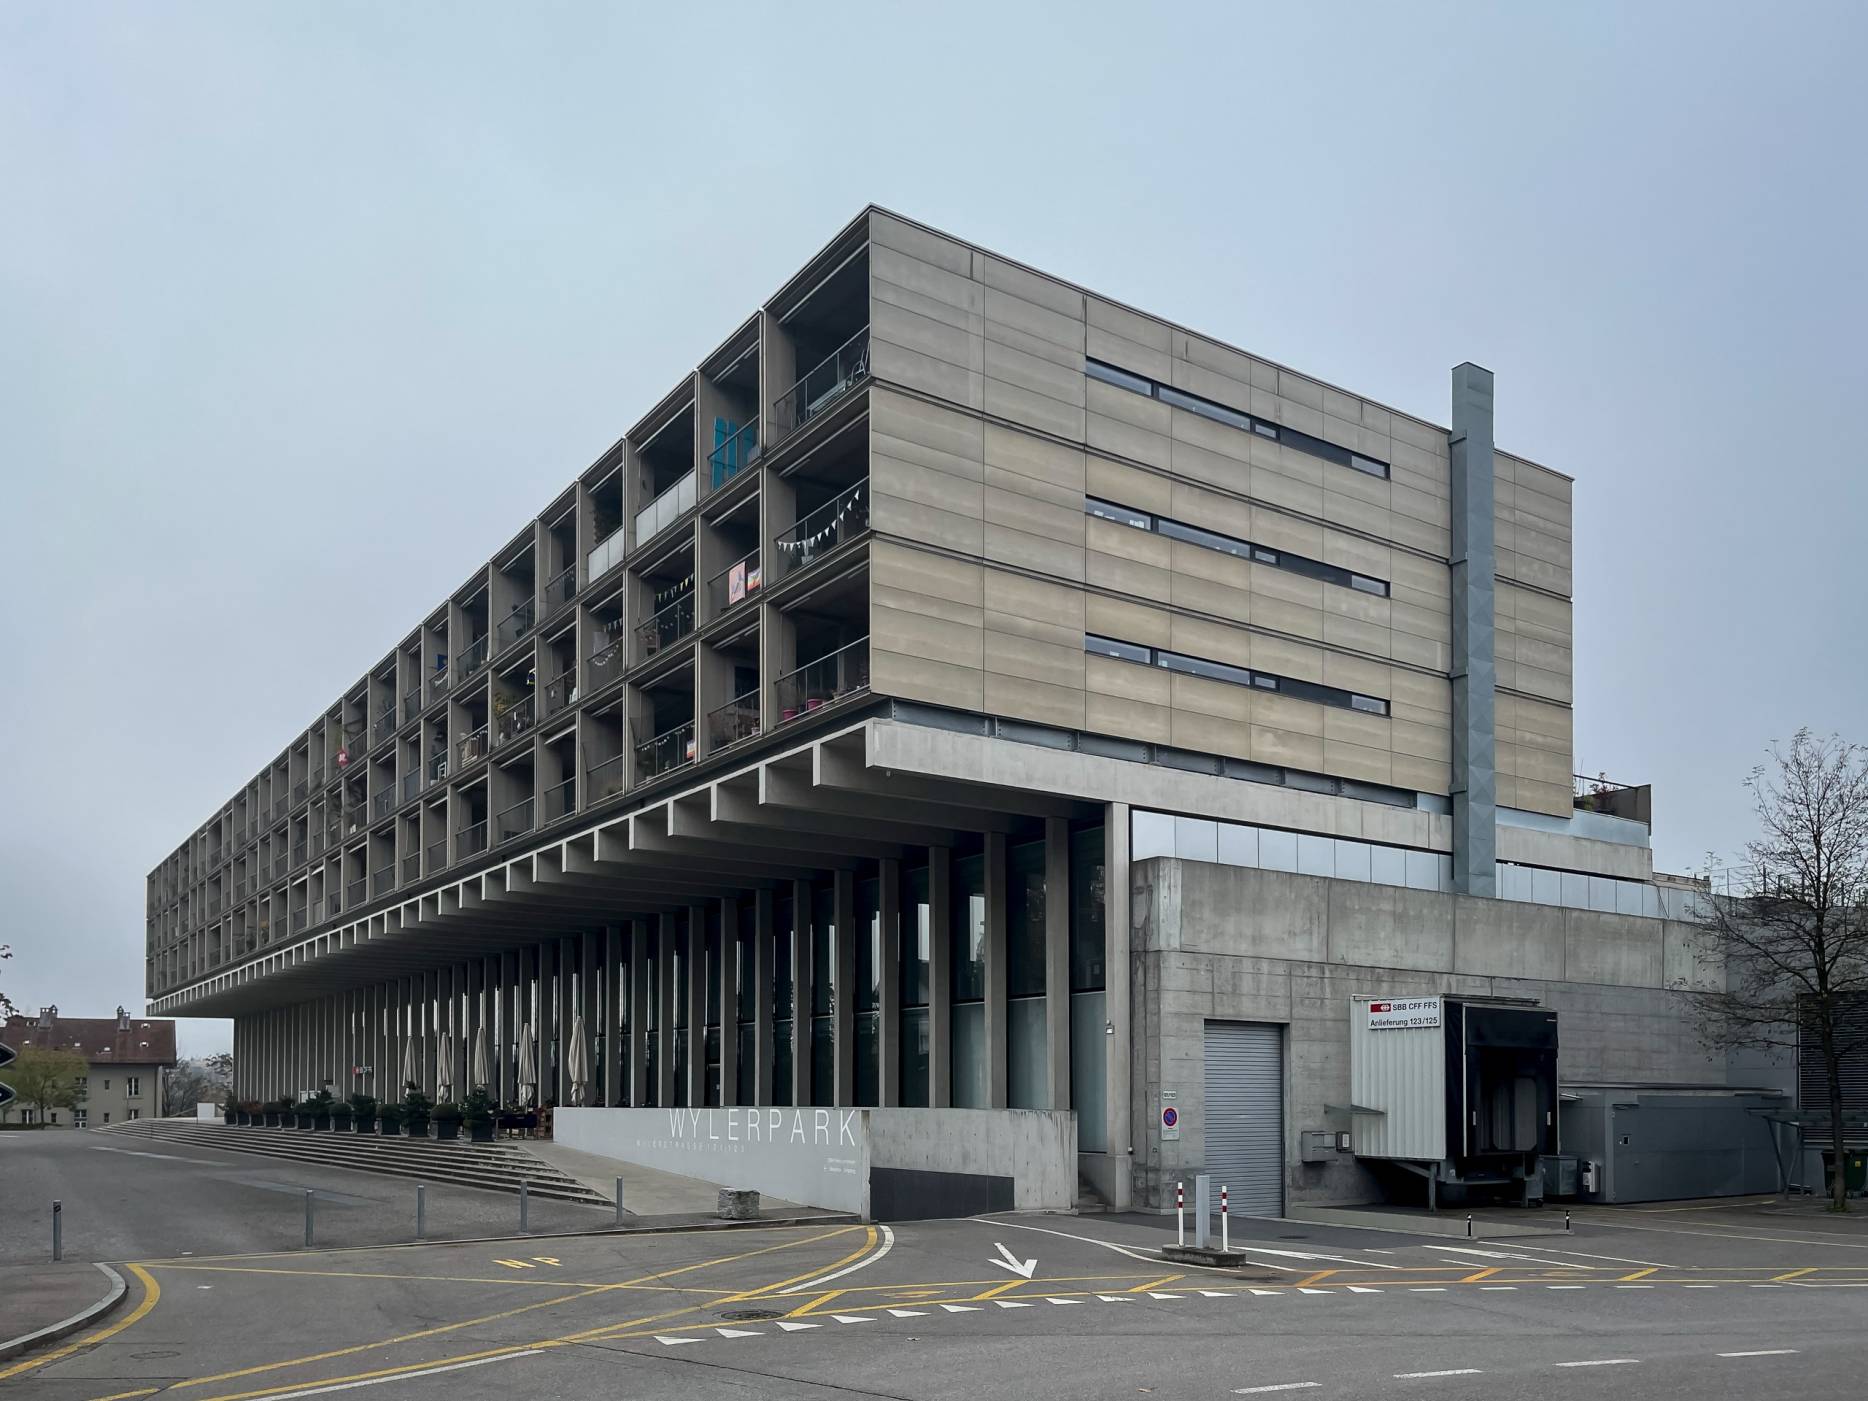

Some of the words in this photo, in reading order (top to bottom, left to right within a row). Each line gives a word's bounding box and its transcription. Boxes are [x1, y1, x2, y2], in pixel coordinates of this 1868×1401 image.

[1392, 1003, 1407, 1011] SBB
[1409, 1002, 1422, 1010] CFF
[1423, 1001, 1438, 1009] FFS
[1370, 1018, 1408, 1027] Anlieferung
[1410, 1016, 1438, 1025] 123/125
[669, 1107, 856, 1147] WYLERPARK
